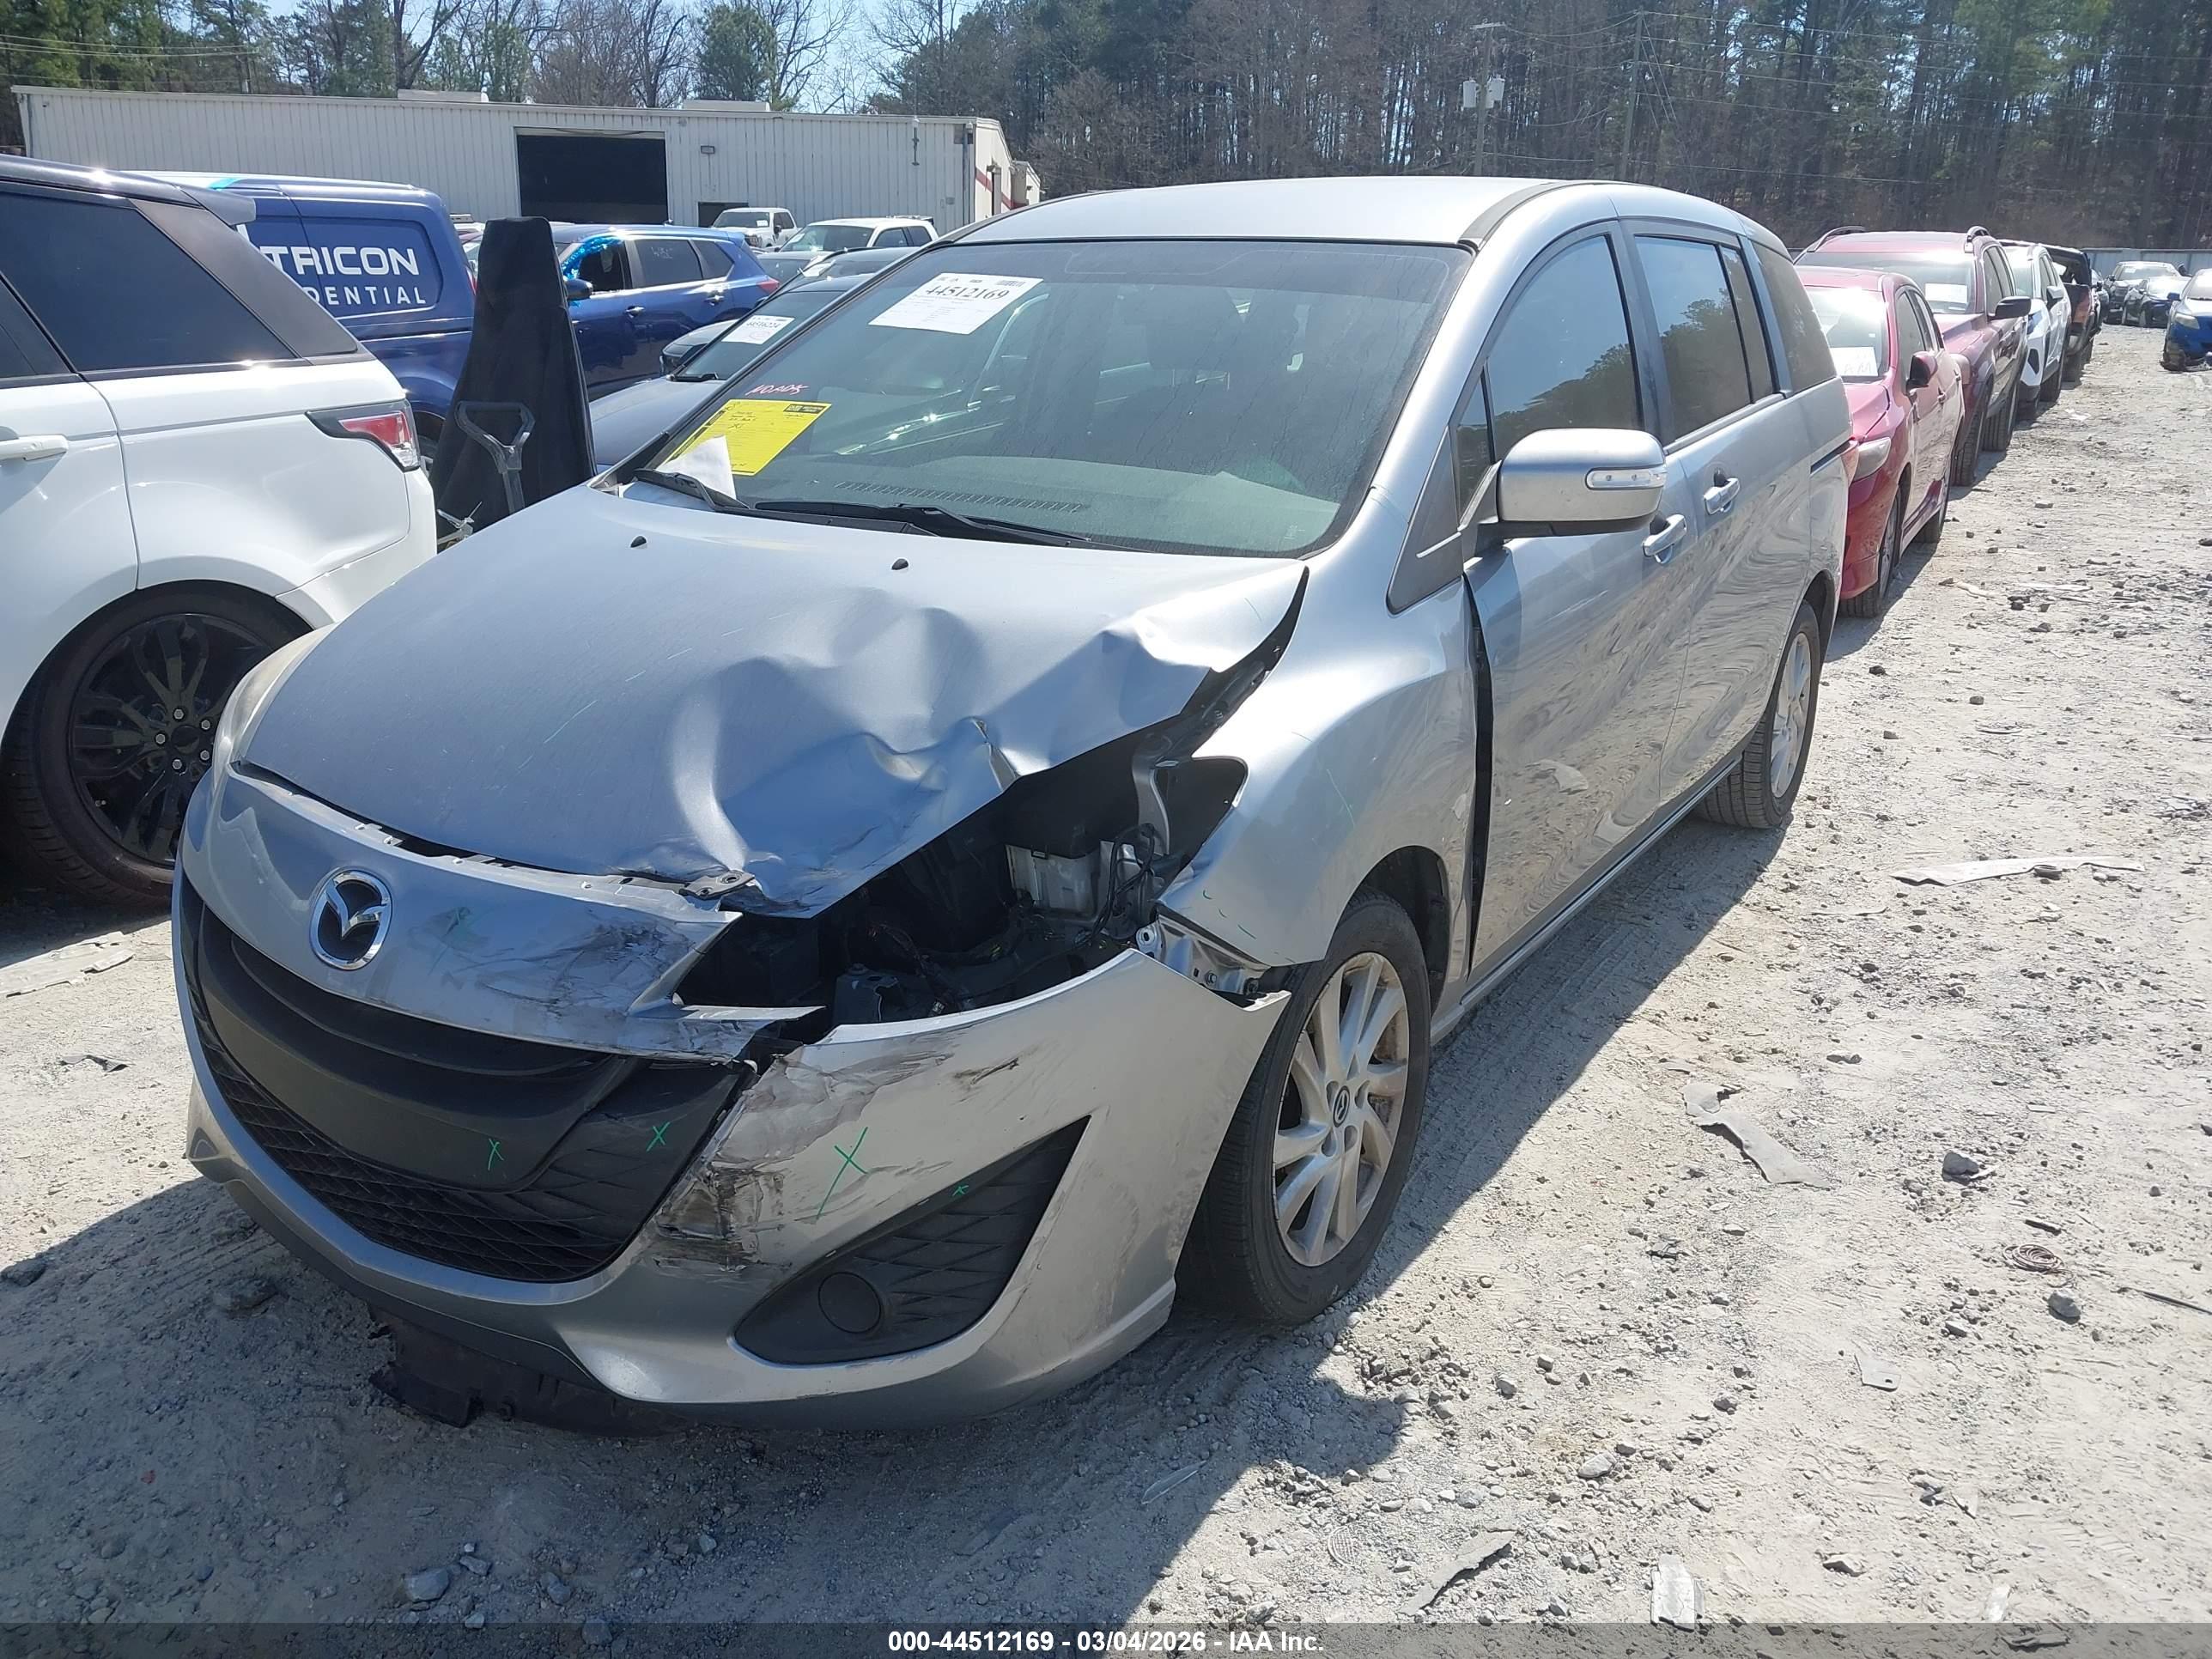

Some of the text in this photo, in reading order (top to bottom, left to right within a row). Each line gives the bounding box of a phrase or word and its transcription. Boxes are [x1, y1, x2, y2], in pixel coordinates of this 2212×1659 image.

[259, 246, 420, 276] TRICON
[303, 286, 427, 306] DENTIAL
[926, 284, 1010, 300] 44512169
